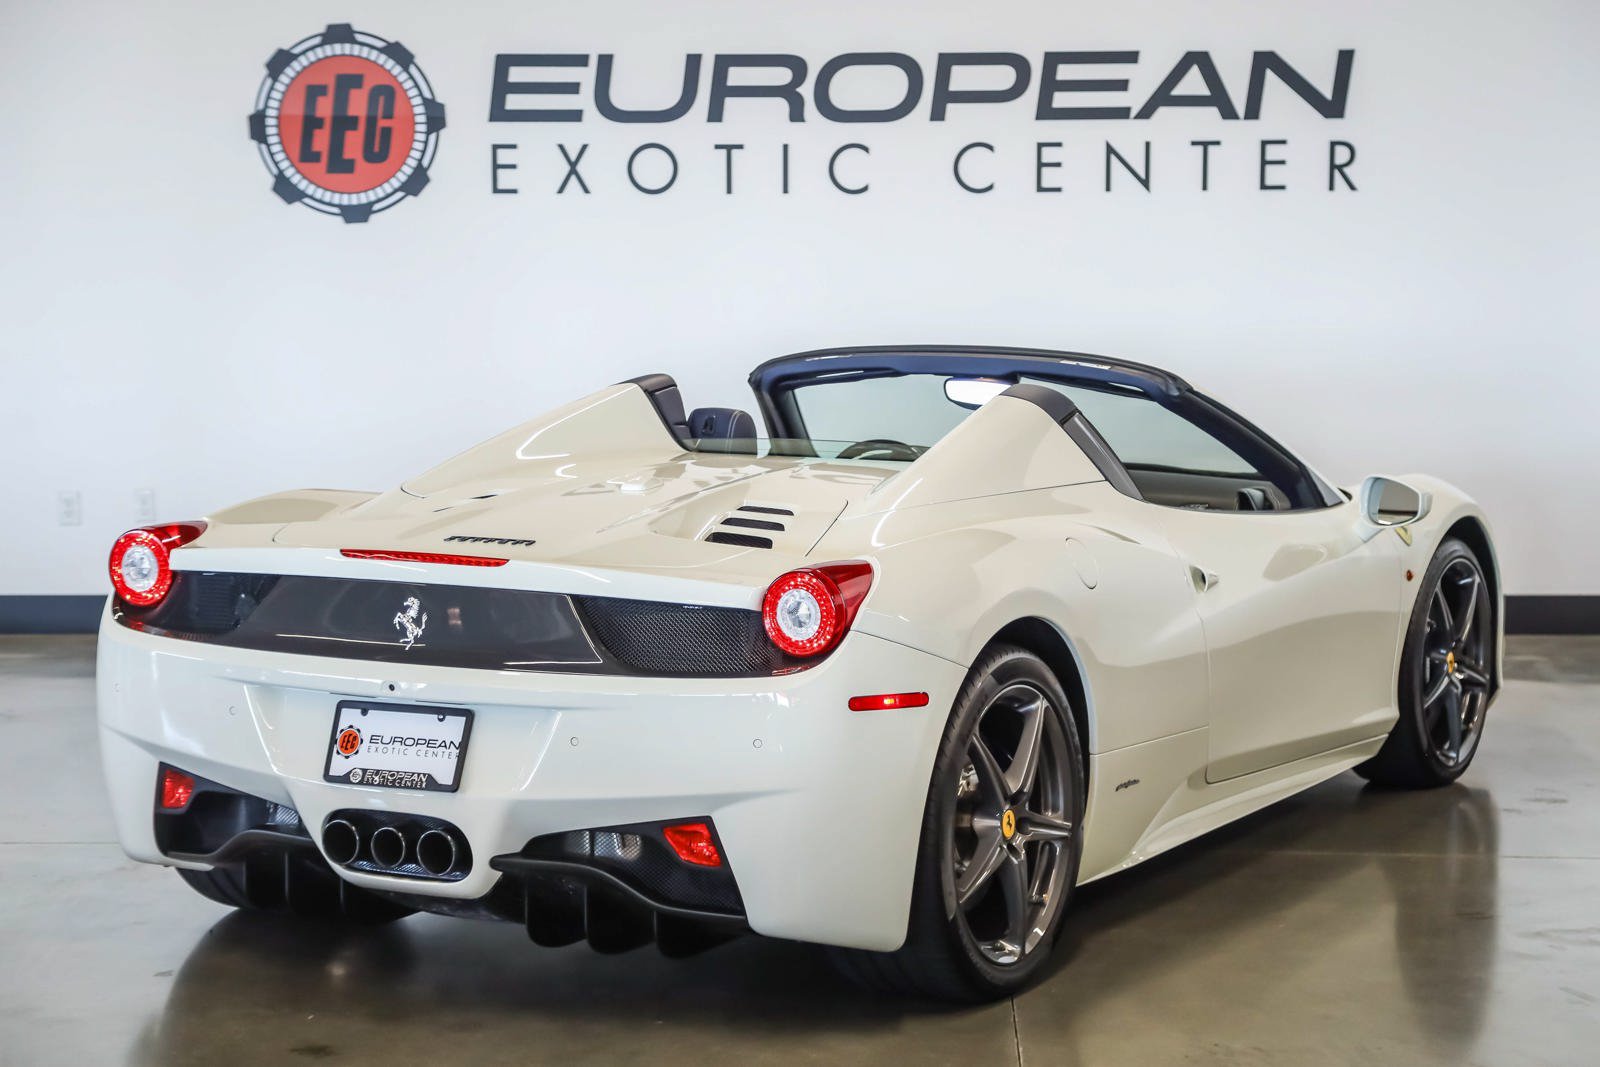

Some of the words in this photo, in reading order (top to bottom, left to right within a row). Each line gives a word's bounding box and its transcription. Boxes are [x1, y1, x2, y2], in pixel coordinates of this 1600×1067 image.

[489, 49, 1355, 123] EUROPEAN
[300, 73, 395, 174] EEC
[491, 142, 869, 194] EXOTIC
[953, 139, 1357, 193] CENTER
[367, 745, 408, 756] EXOTIC
[369, 734, 460, 750] EUROPEAN
[364, 769, 428, 782] EUROPEAN
